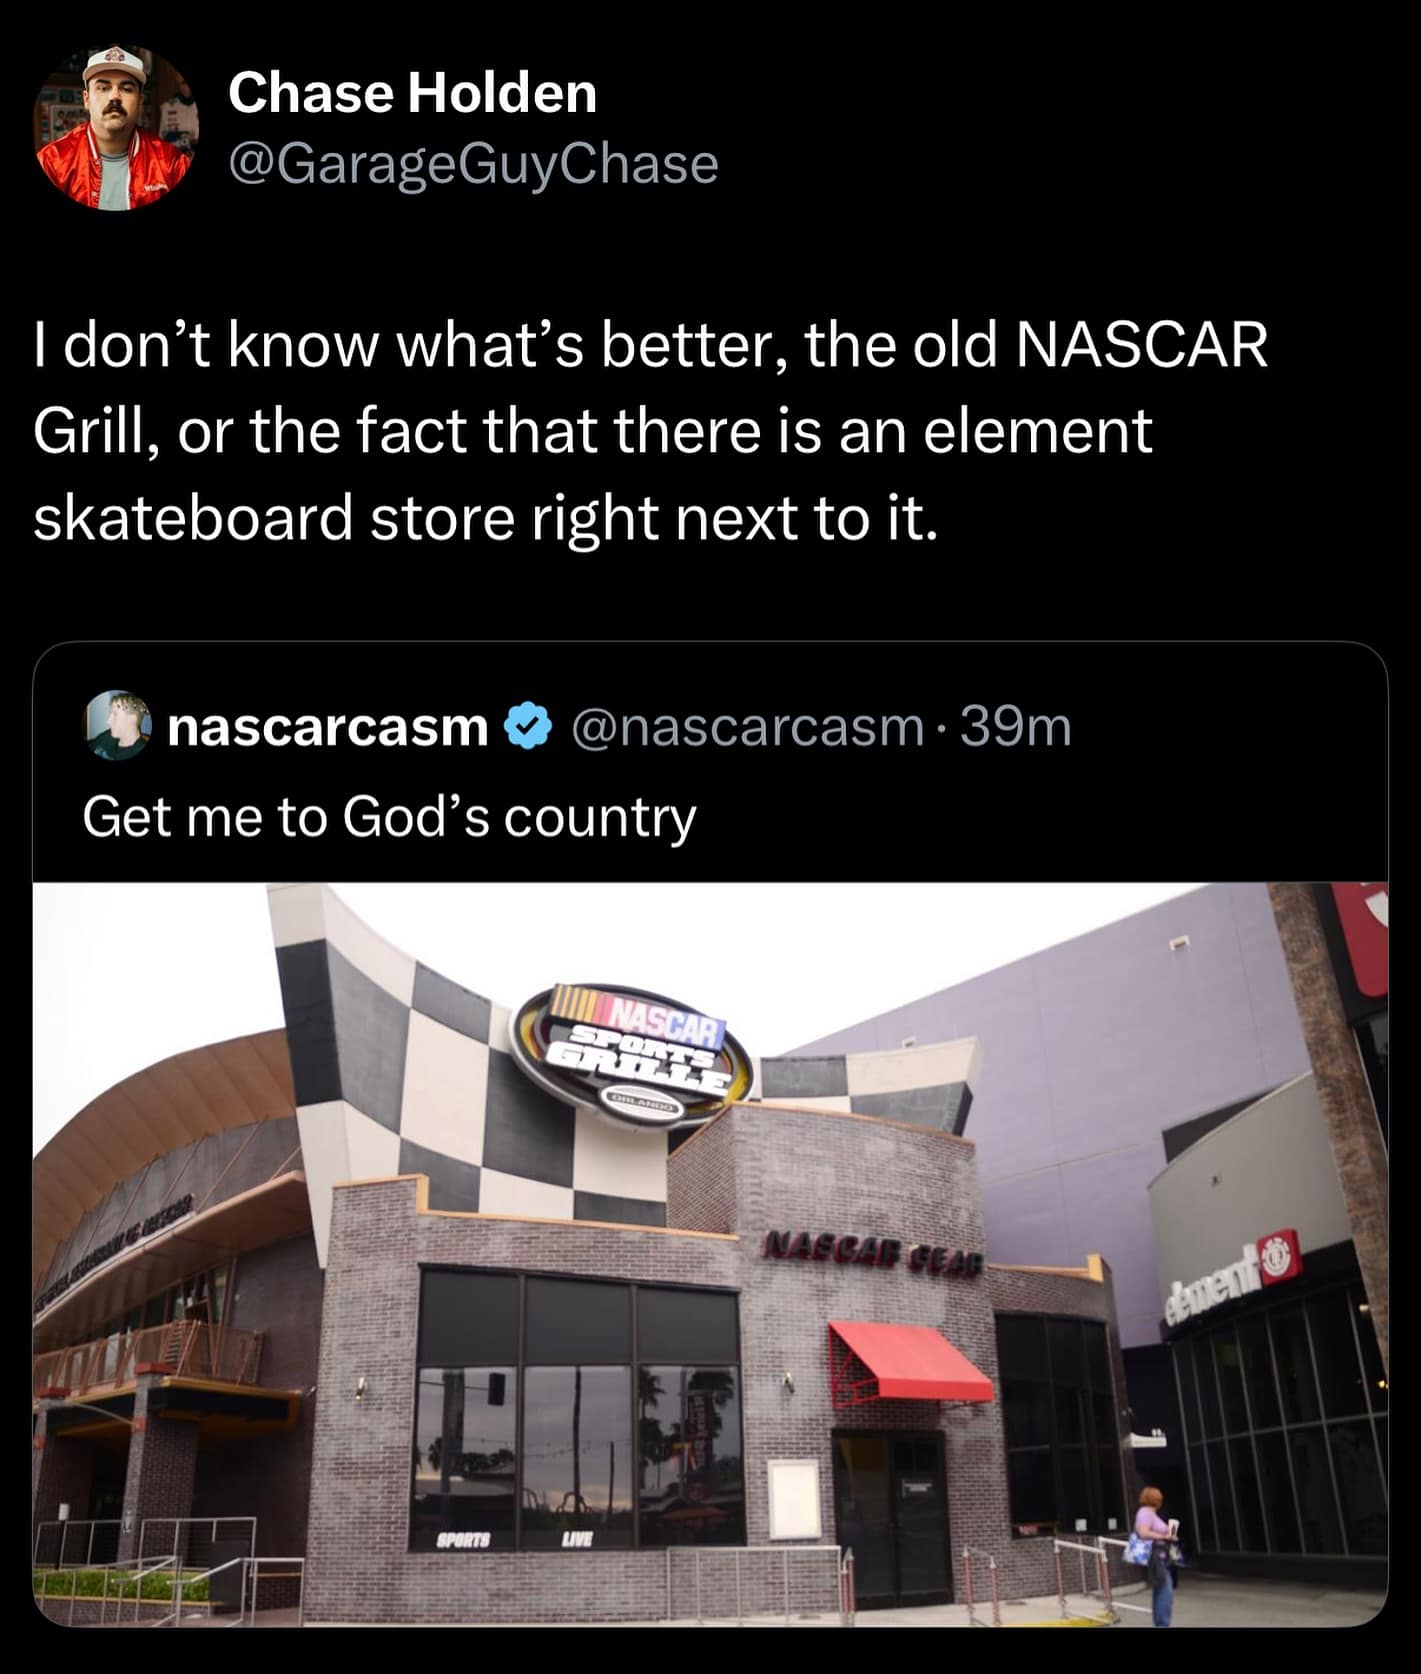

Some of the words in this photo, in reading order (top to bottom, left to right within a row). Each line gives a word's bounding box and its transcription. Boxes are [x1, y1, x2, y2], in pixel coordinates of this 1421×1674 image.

[569, 1024, 716, 1068] SPORTS
[607, 997, 718, 1050] NASCAR
[545, 1041, 732, 1096] GRILLE
[610, 1094, 676, 1112] ORLANDO
[763, 1230, 902, 1268] NASCAR
[908, 1244, 984, 1277] GEAR
[1165, 1243, 1262, 1327] element
[436, 1532, 491, 1548] SPORTS
[561, 1531, 594, 1548] LIVE
